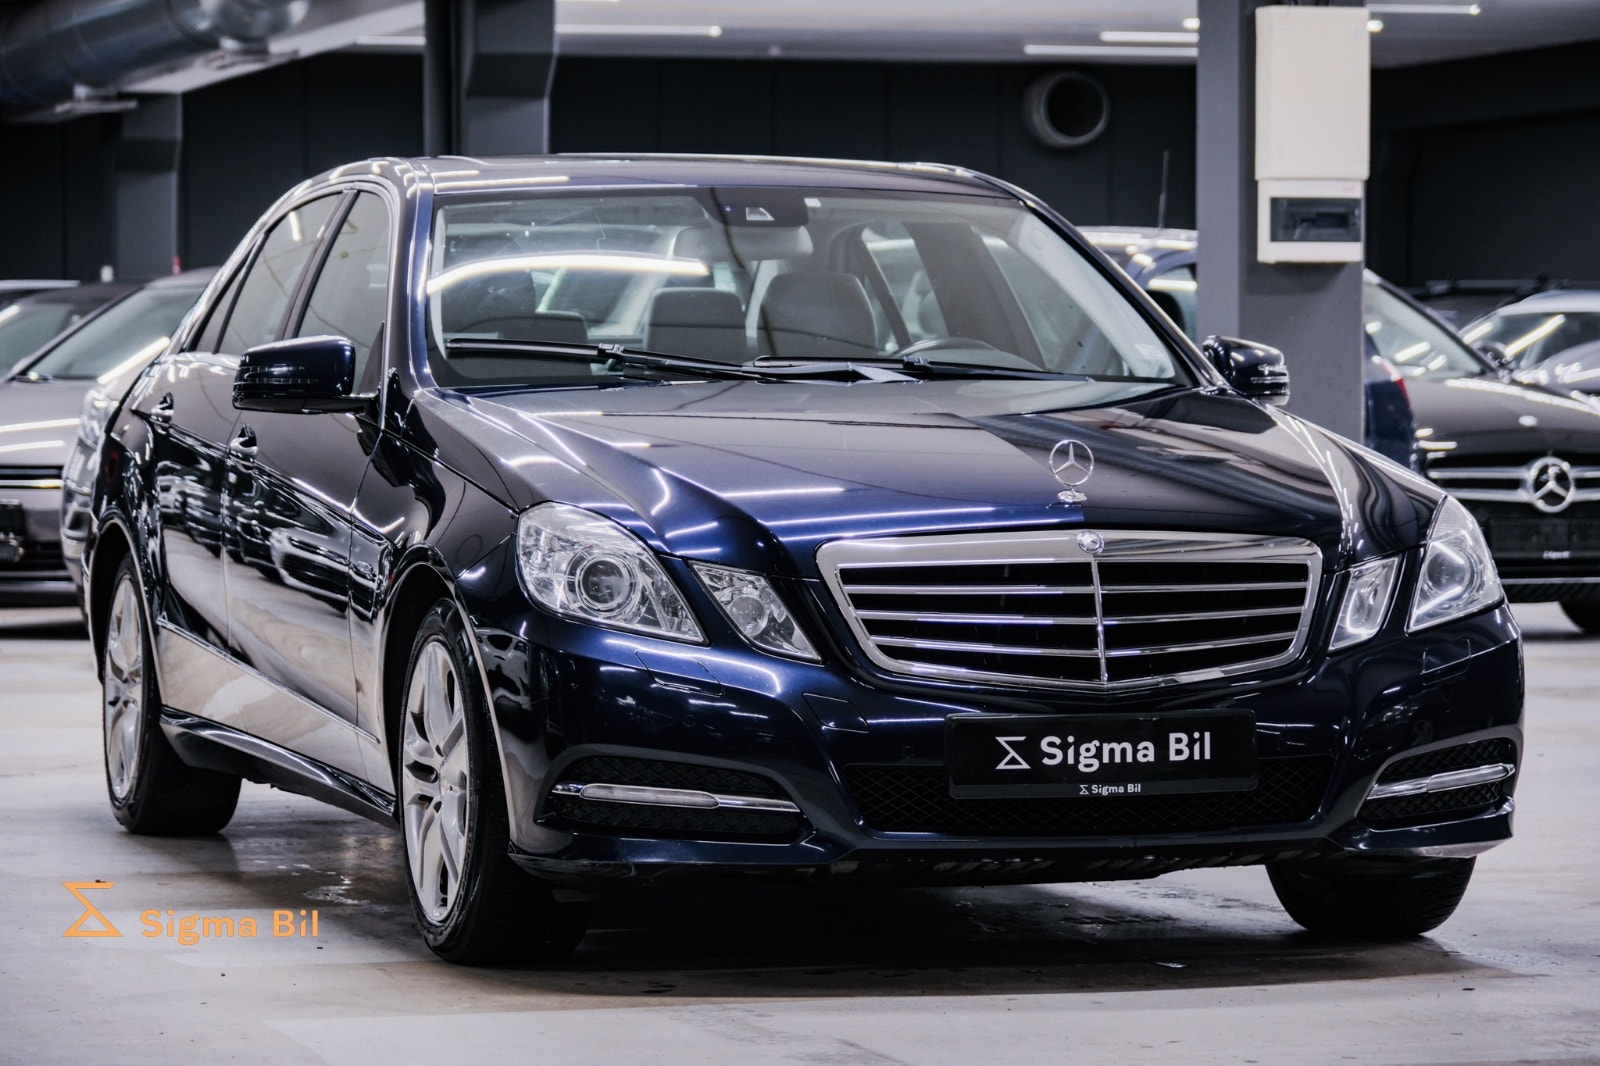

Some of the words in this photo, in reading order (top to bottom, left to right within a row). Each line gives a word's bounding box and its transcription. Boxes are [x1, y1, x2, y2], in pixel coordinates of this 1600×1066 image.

[1040, 735, 1155, 772] Sigma
[1168, 731, 1211, 761] Bil
[1091, 784, 1125, 796] Sigma
[1127, 783, 1142, 794] Bil
